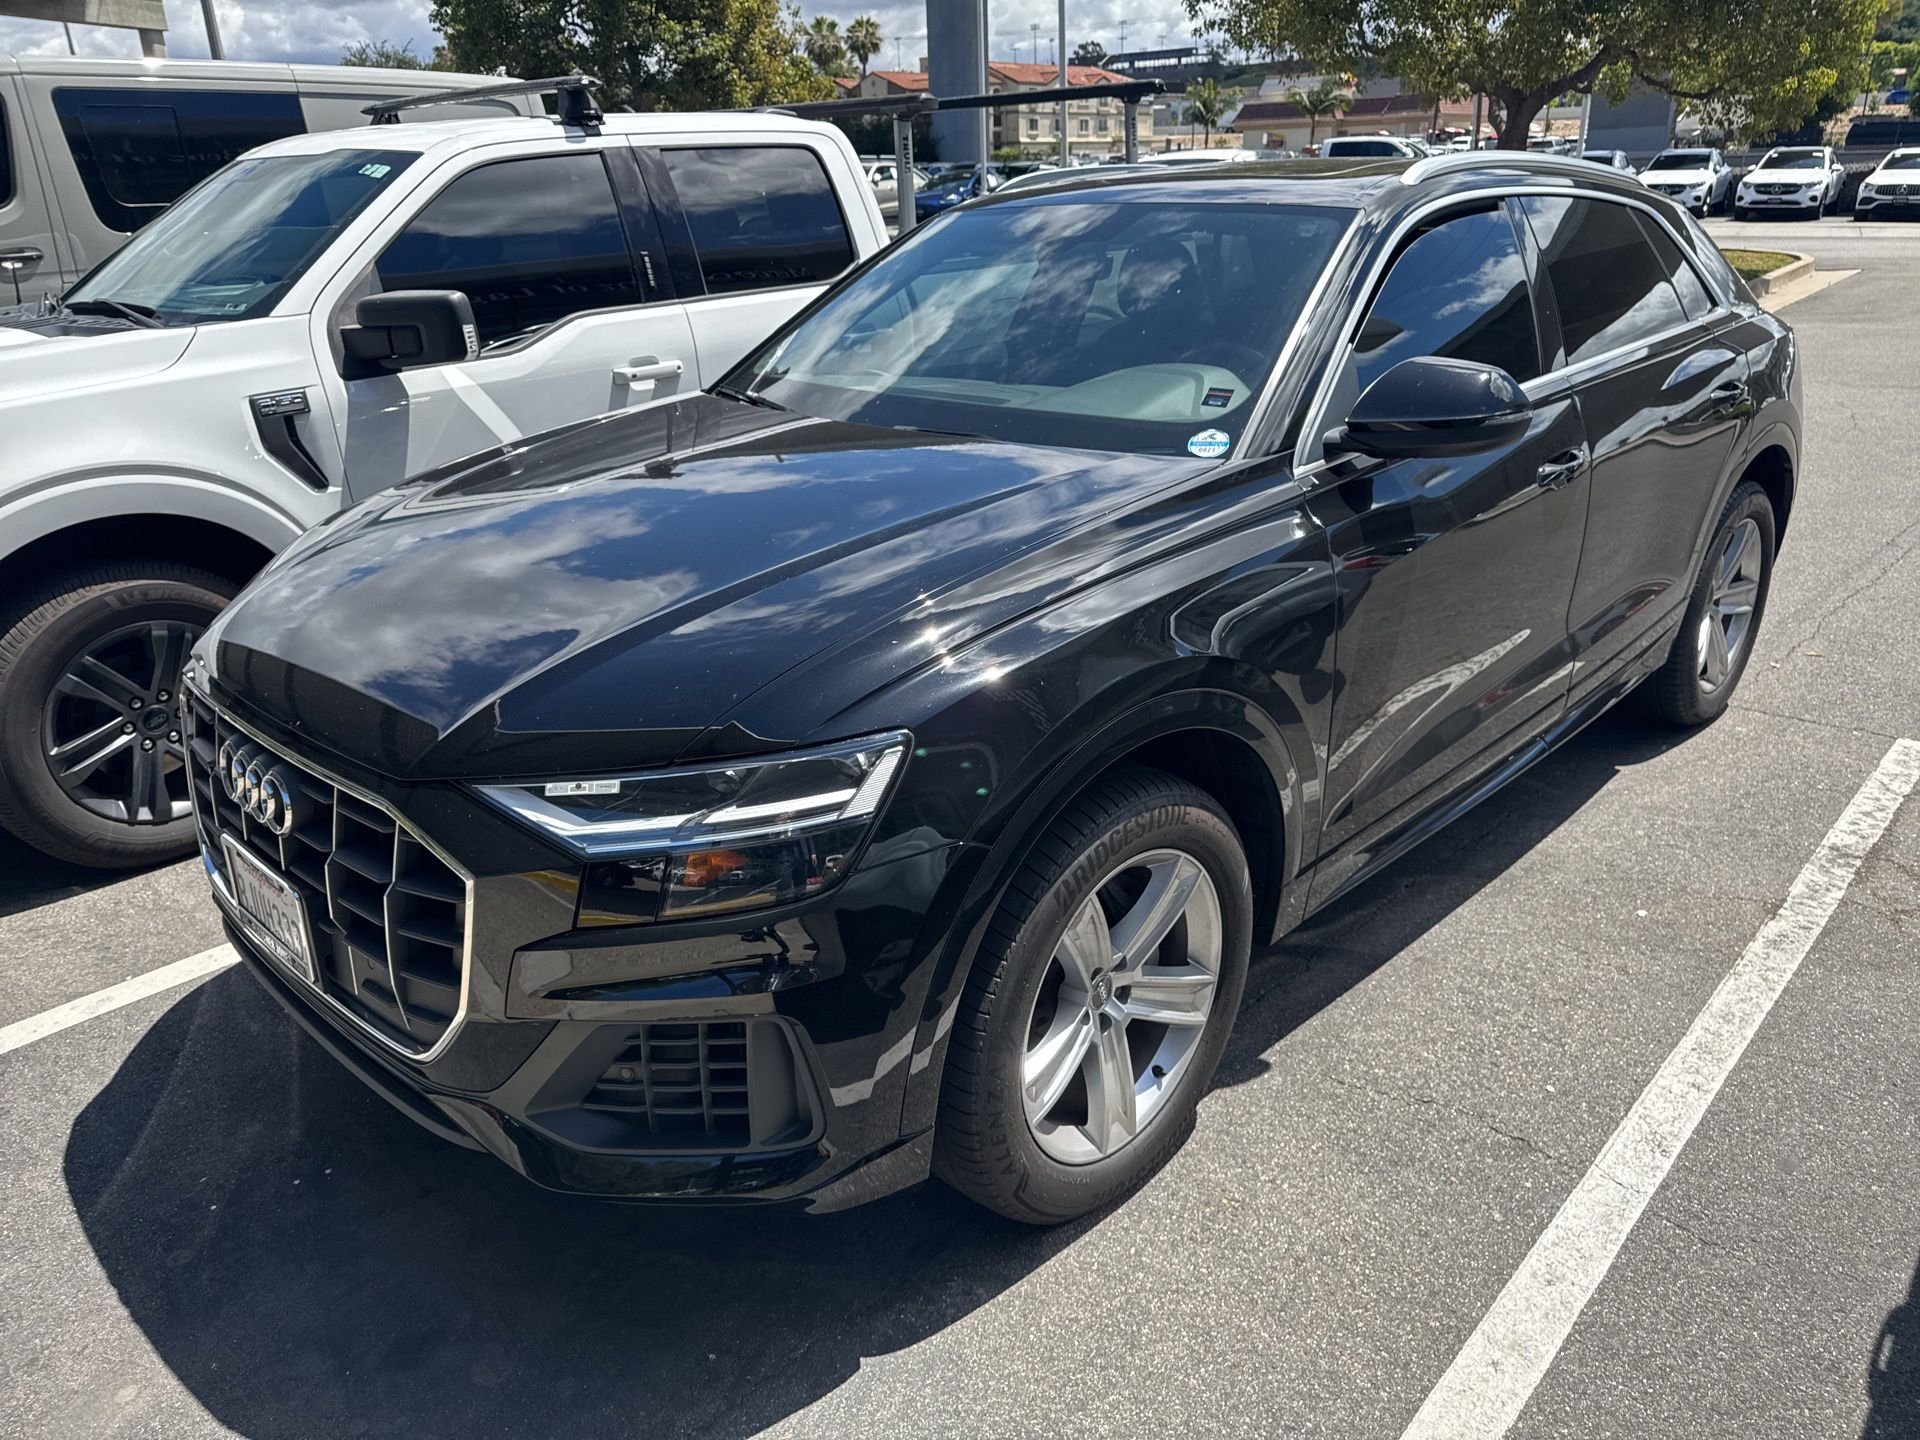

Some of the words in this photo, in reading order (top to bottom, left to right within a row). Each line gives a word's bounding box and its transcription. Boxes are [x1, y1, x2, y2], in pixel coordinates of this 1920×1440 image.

[902, 134, 912, 174] THULE
[1053, 805, 1191, 912] BRIDGESTONE
[987, 1063, 1017, 1175] ALENZA
